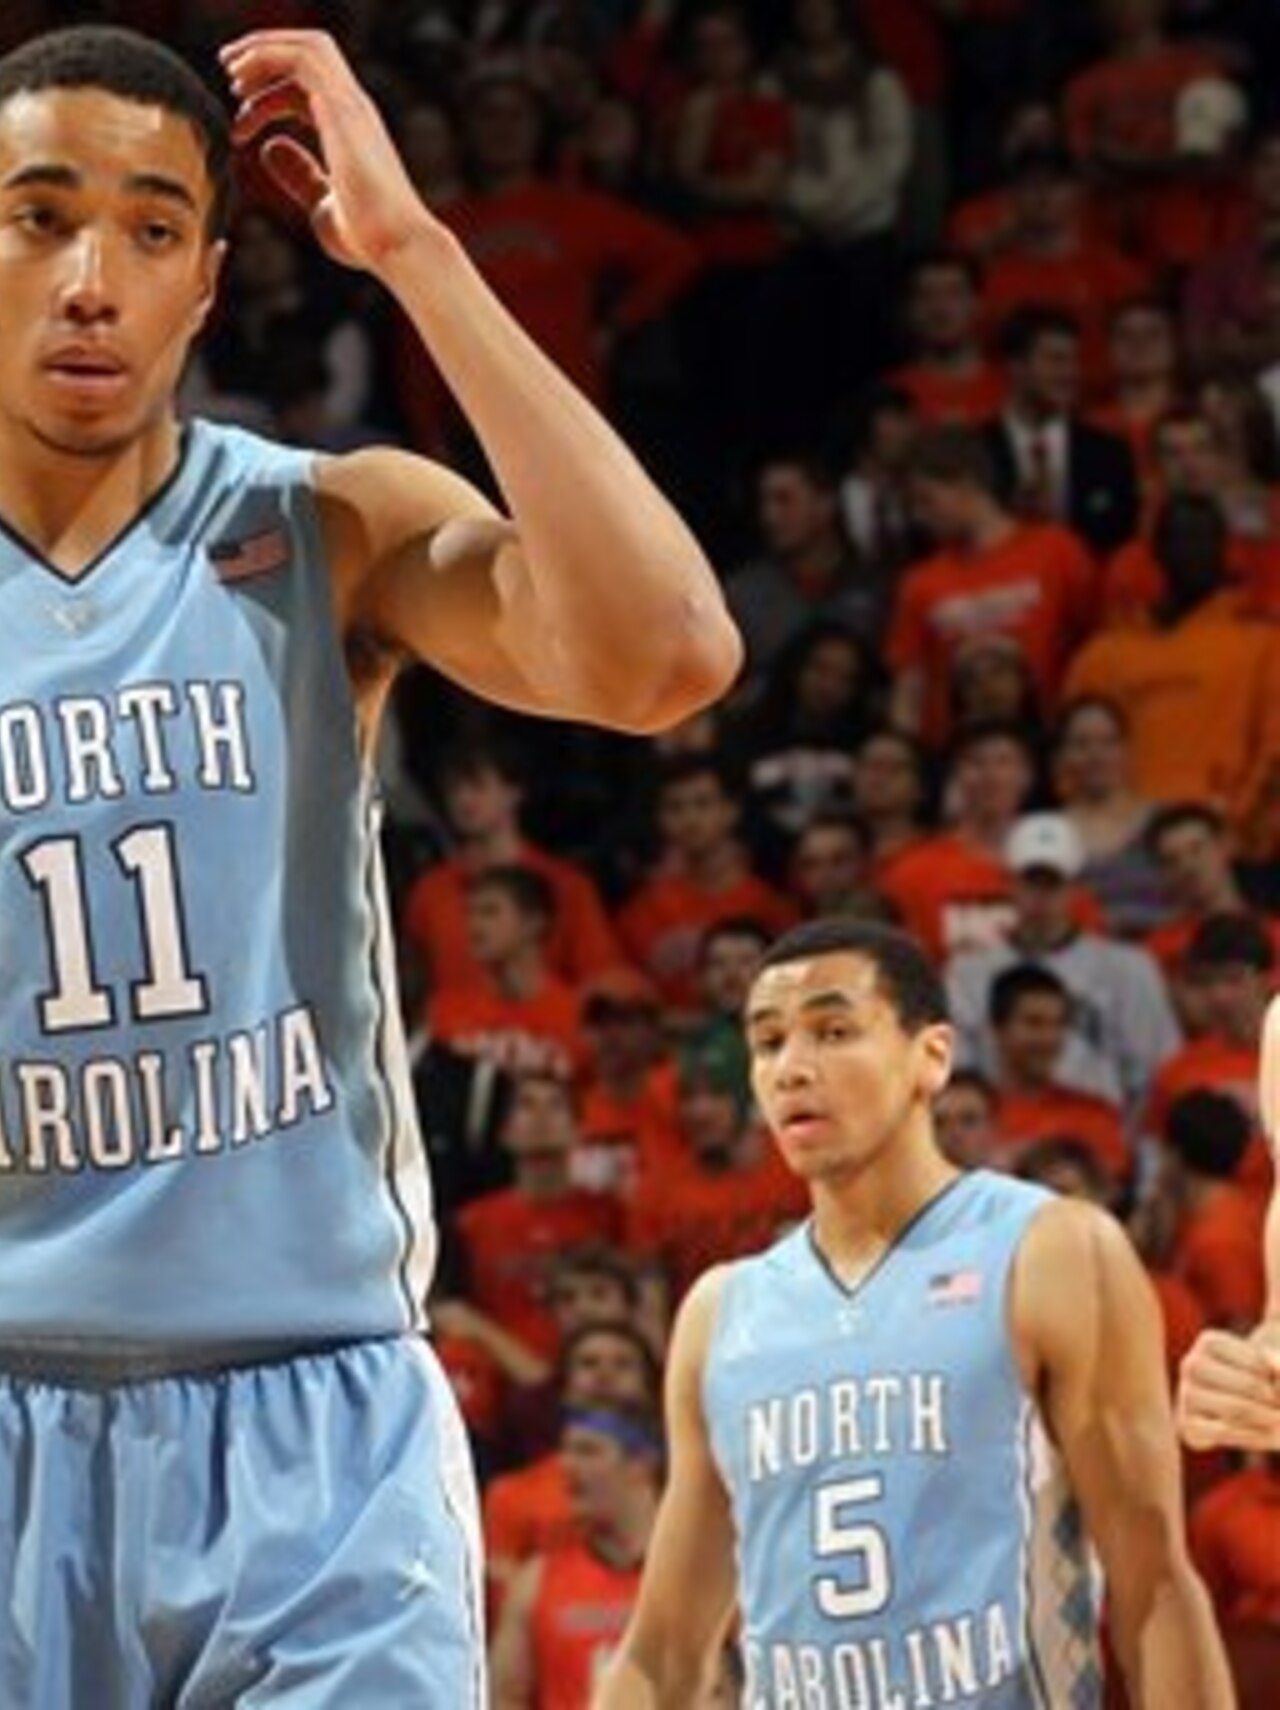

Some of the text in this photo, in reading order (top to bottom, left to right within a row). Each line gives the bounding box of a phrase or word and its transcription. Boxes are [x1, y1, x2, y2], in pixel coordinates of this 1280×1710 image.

[19, 818, 211, 1036] 11
[744, 1371, 950, 1484] NORTH
[811, 1470, 893, 1623] 5
[742, 1599, 1016, 1710] CAROLINA
